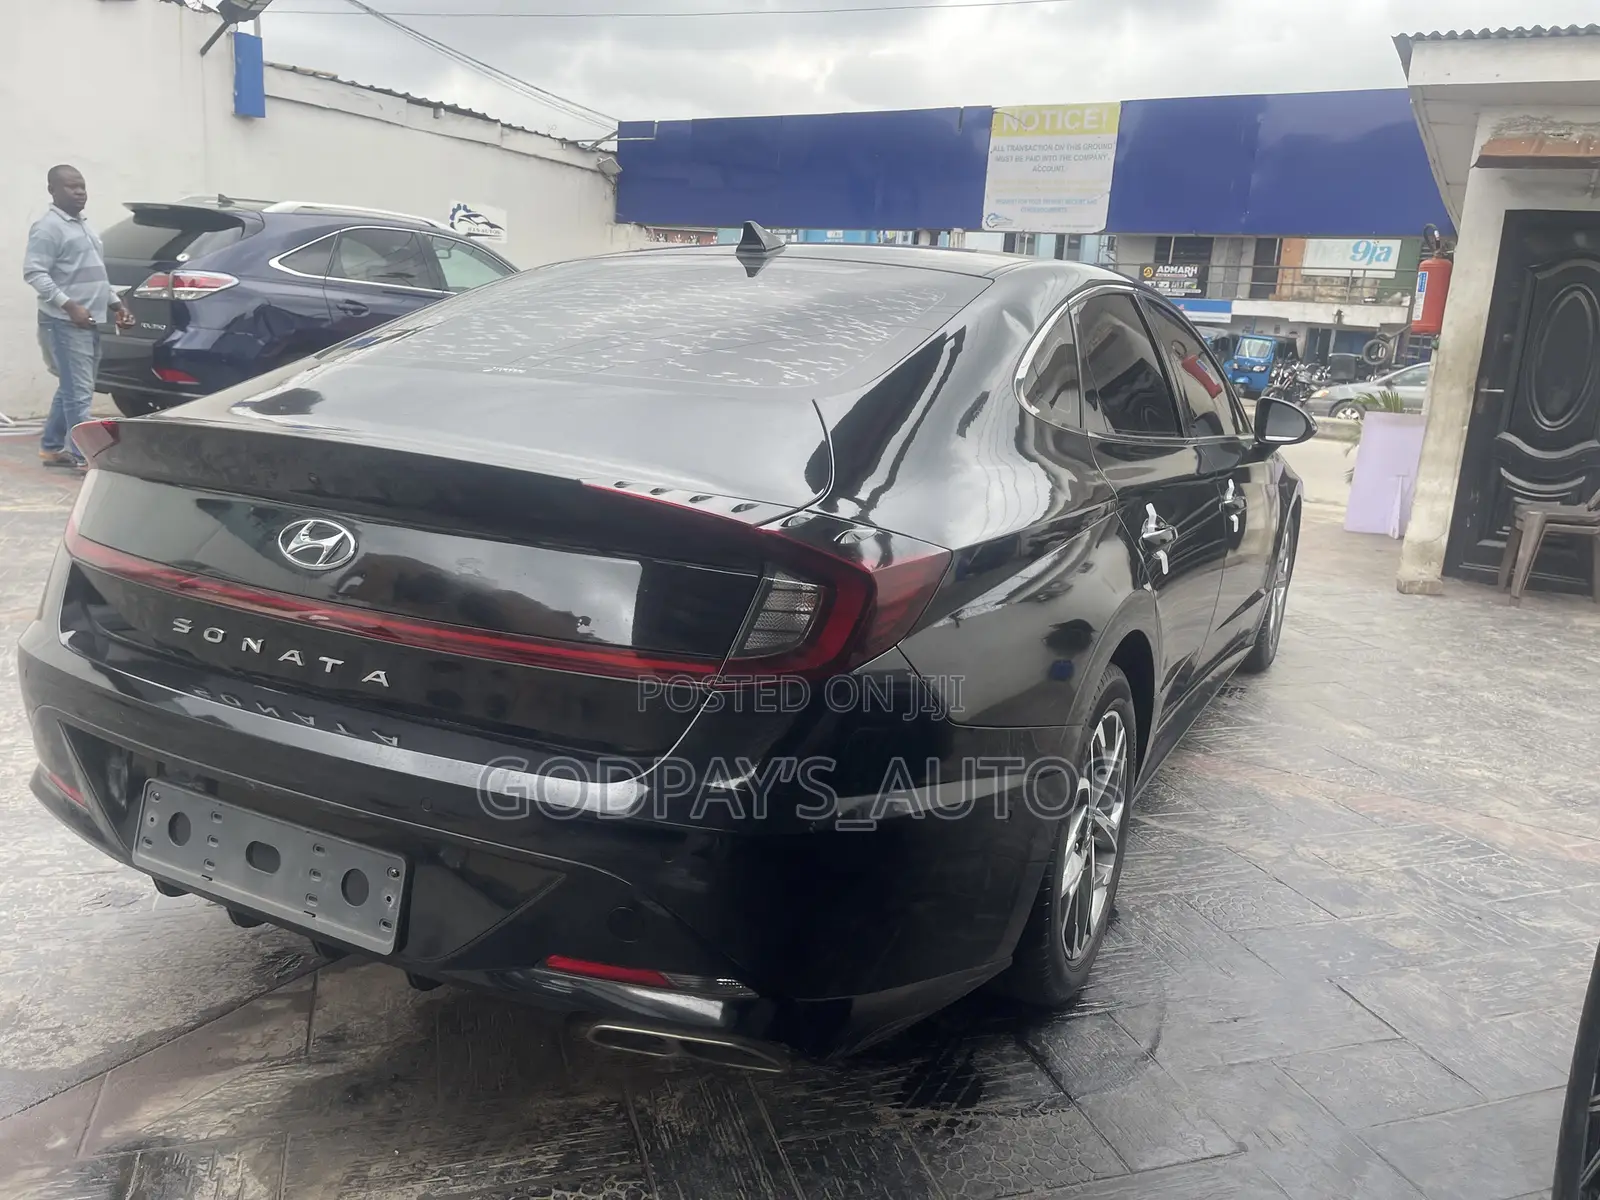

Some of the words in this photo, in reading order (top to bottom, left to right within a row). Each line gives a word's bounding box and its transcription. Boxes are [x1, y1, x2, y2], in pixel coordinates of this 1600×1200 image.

[1003, 108, 1109, 132] NOTICE!
[992, 144, 1005, 152] ALL
[1006, 143, 1053, 152] TRANSACTION
[1054, 143, 1065, 151] ON
[1066, 142, 1081, 151] THIS
[1082, 142, 1113, 151] GROUND
[995, 155, 1013, 163] MUST
[1025, 154, 1041, 162] PAID
[1042, 154, 1058, 162] INTO
[172, 618, 389, 688] SONATA
